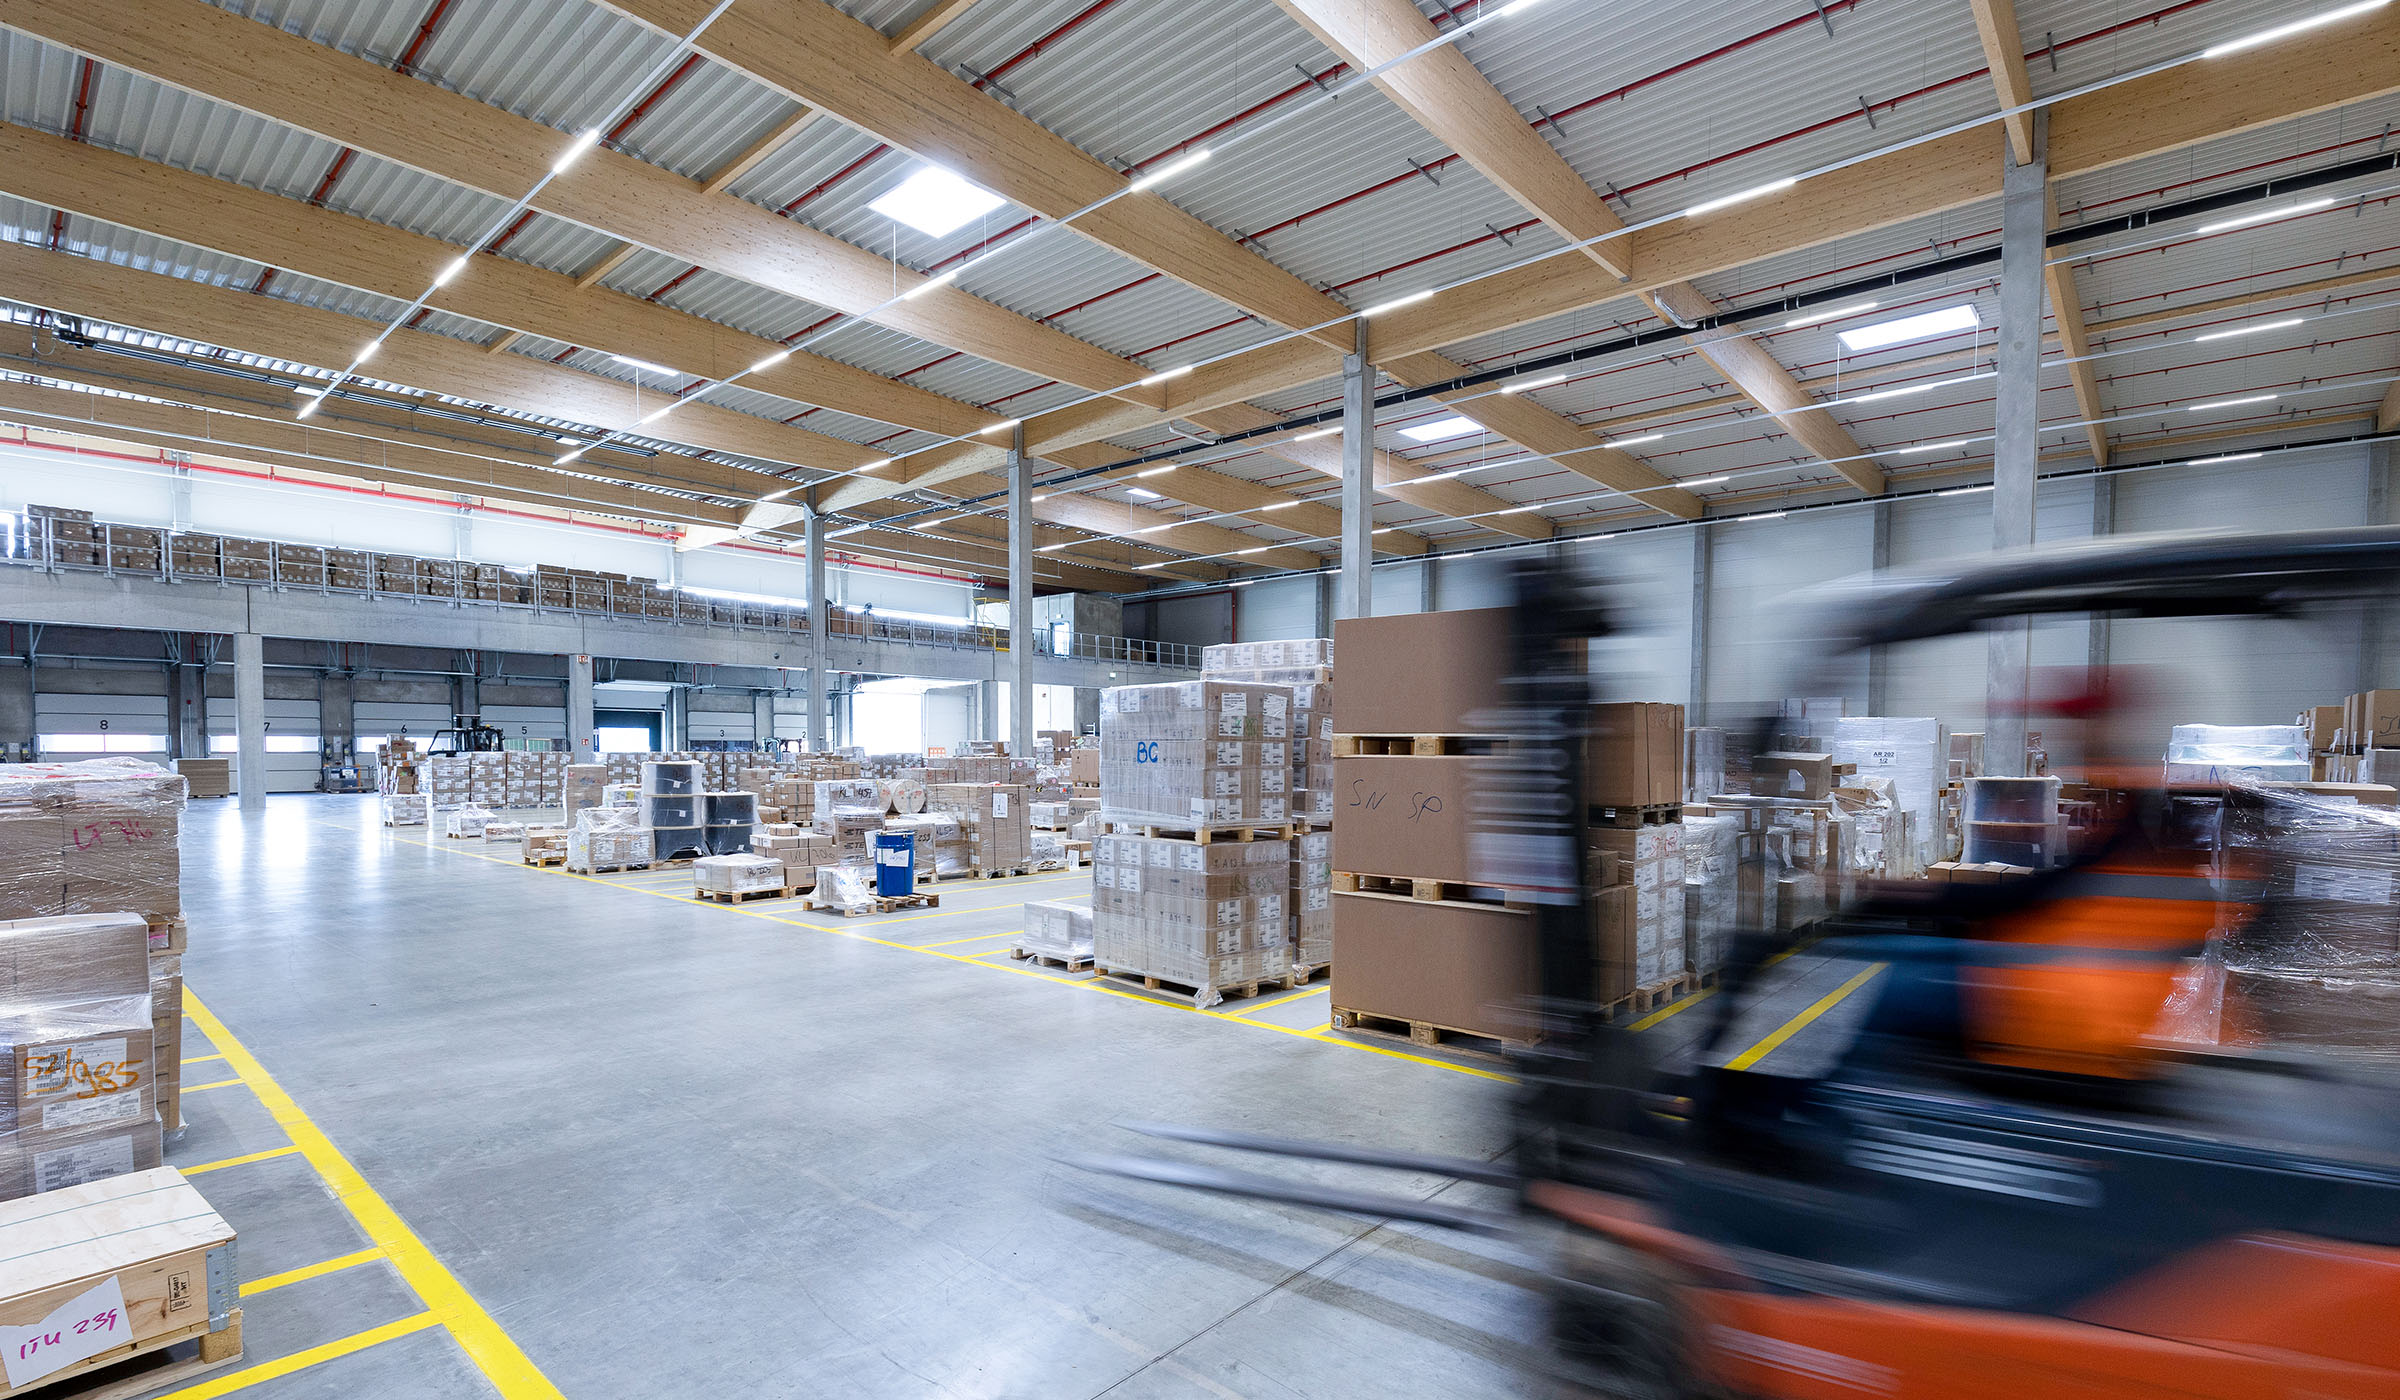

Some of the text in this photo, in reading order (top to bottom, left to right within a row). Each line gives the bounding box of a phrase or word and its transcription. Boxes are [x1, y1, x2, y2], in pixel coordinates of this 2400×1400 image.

[99, 720, 109, 730] 8
[264, 722, 271, 732] 7
[400, 724, 408, 734] 6
[521, 726, 528, 735] 5
[719, 729, 725, 738] 3
[802, 731, 807, 739] 2
[1137, 741, 1159, 764] BC
